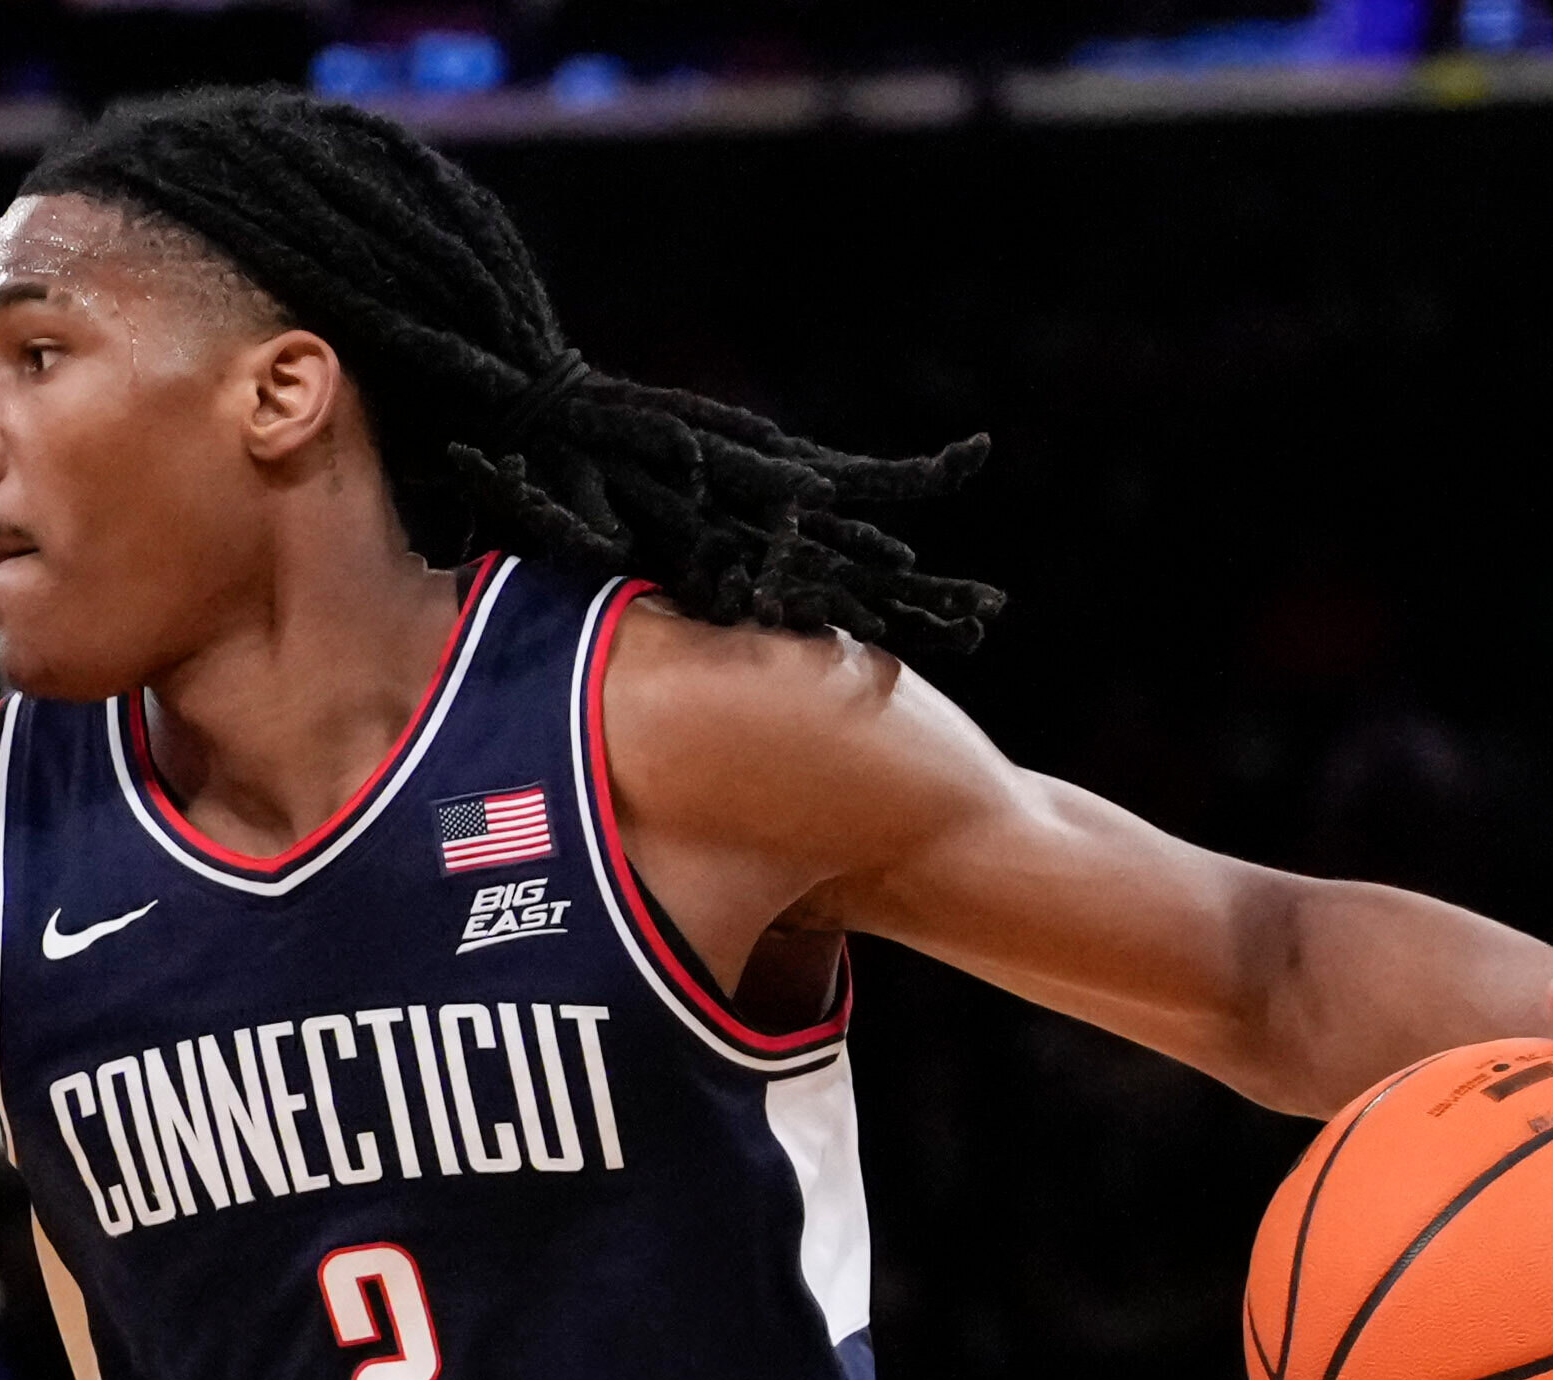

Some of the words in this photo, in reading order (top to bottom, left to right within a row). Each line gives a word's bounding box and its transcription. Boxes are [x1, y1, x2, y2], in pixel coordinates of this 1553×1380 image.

[470, 877, 549, 914] BIG
[461, 900, 572, 940] EAST
[49, 1002, 625, 1238] CONNECTICUT
